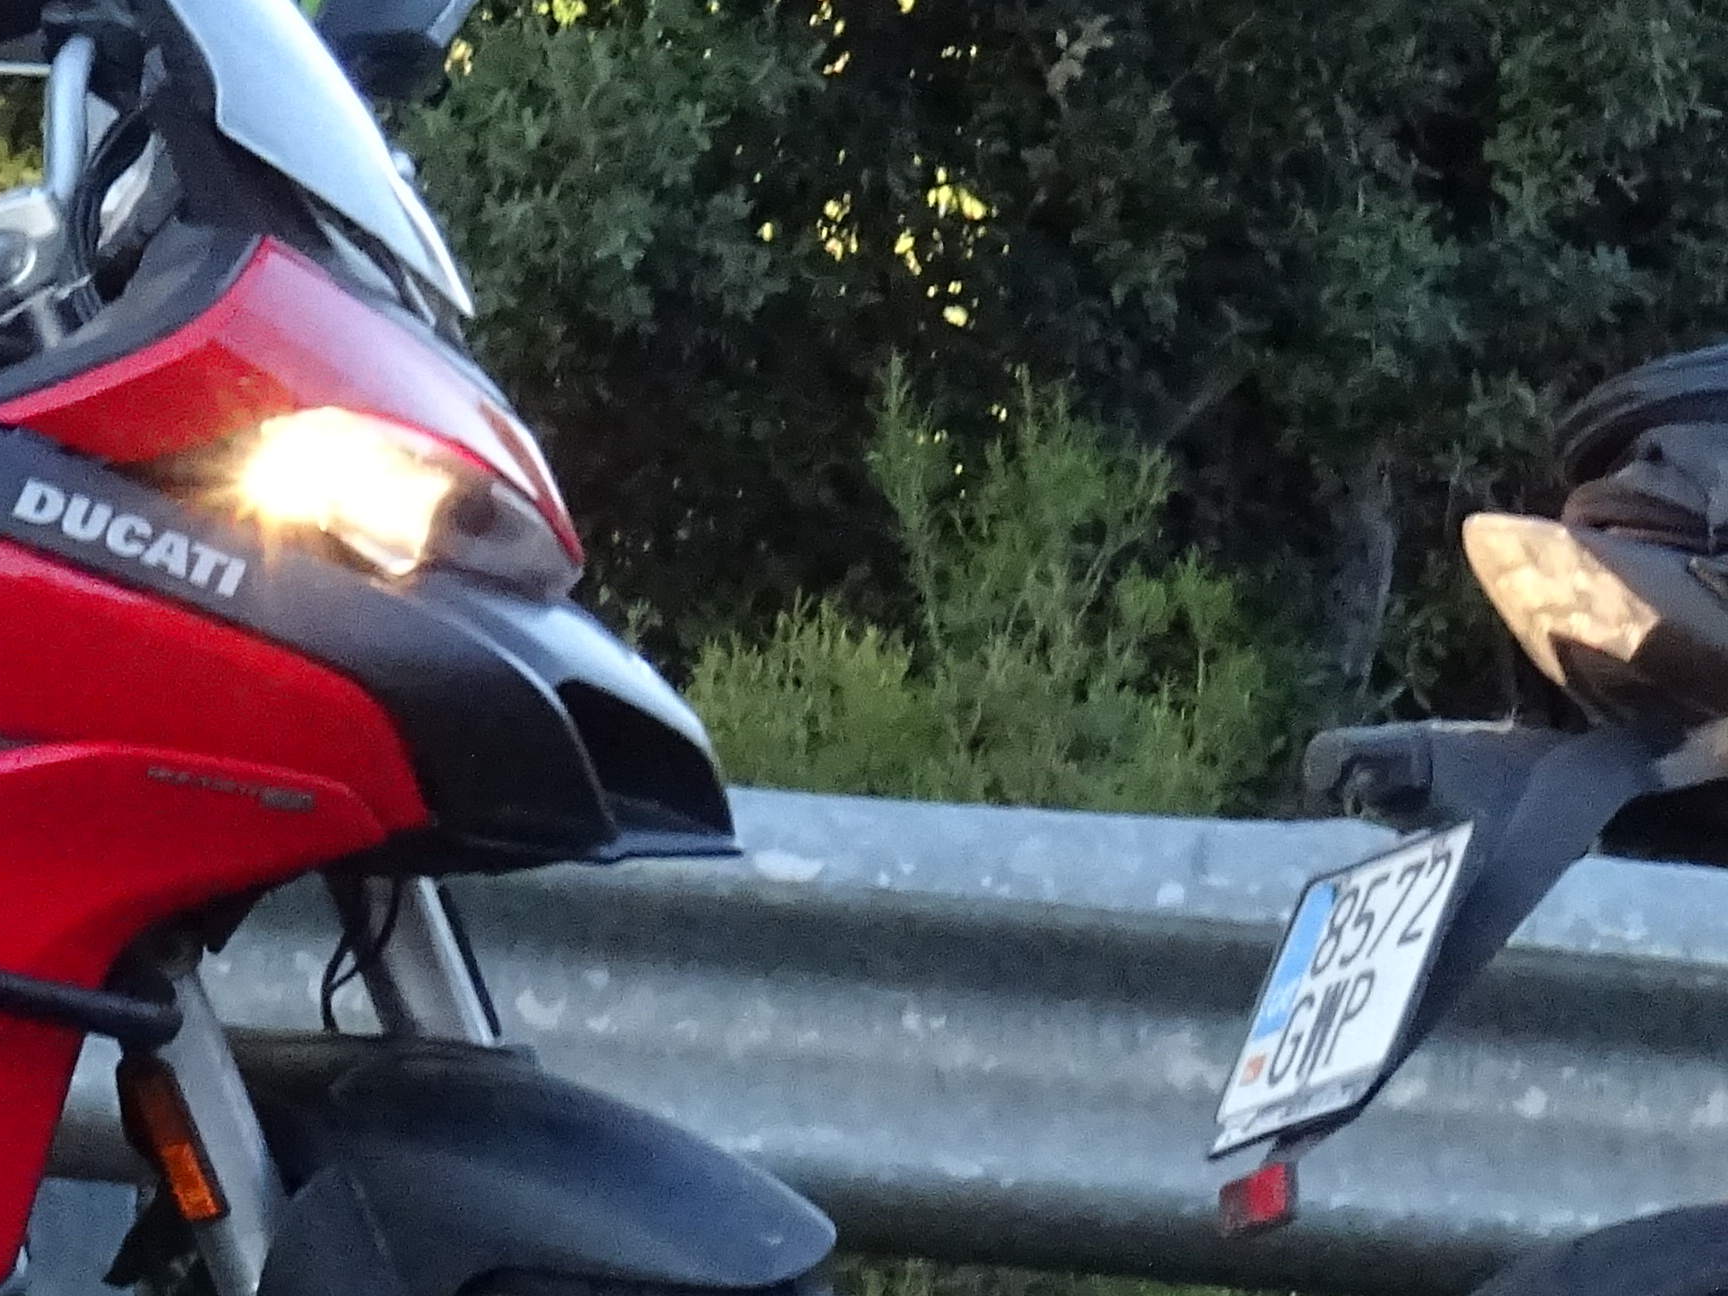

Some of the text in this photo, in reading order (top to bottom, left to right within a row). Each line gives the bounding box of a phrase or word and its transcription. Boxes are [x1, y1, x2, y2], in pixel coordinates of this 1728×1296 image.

[12, 477, 247, 598] DUCATI
[1309, 850, 1453, 977] 8572
[1267, 968, 1376, 1089] GWP
